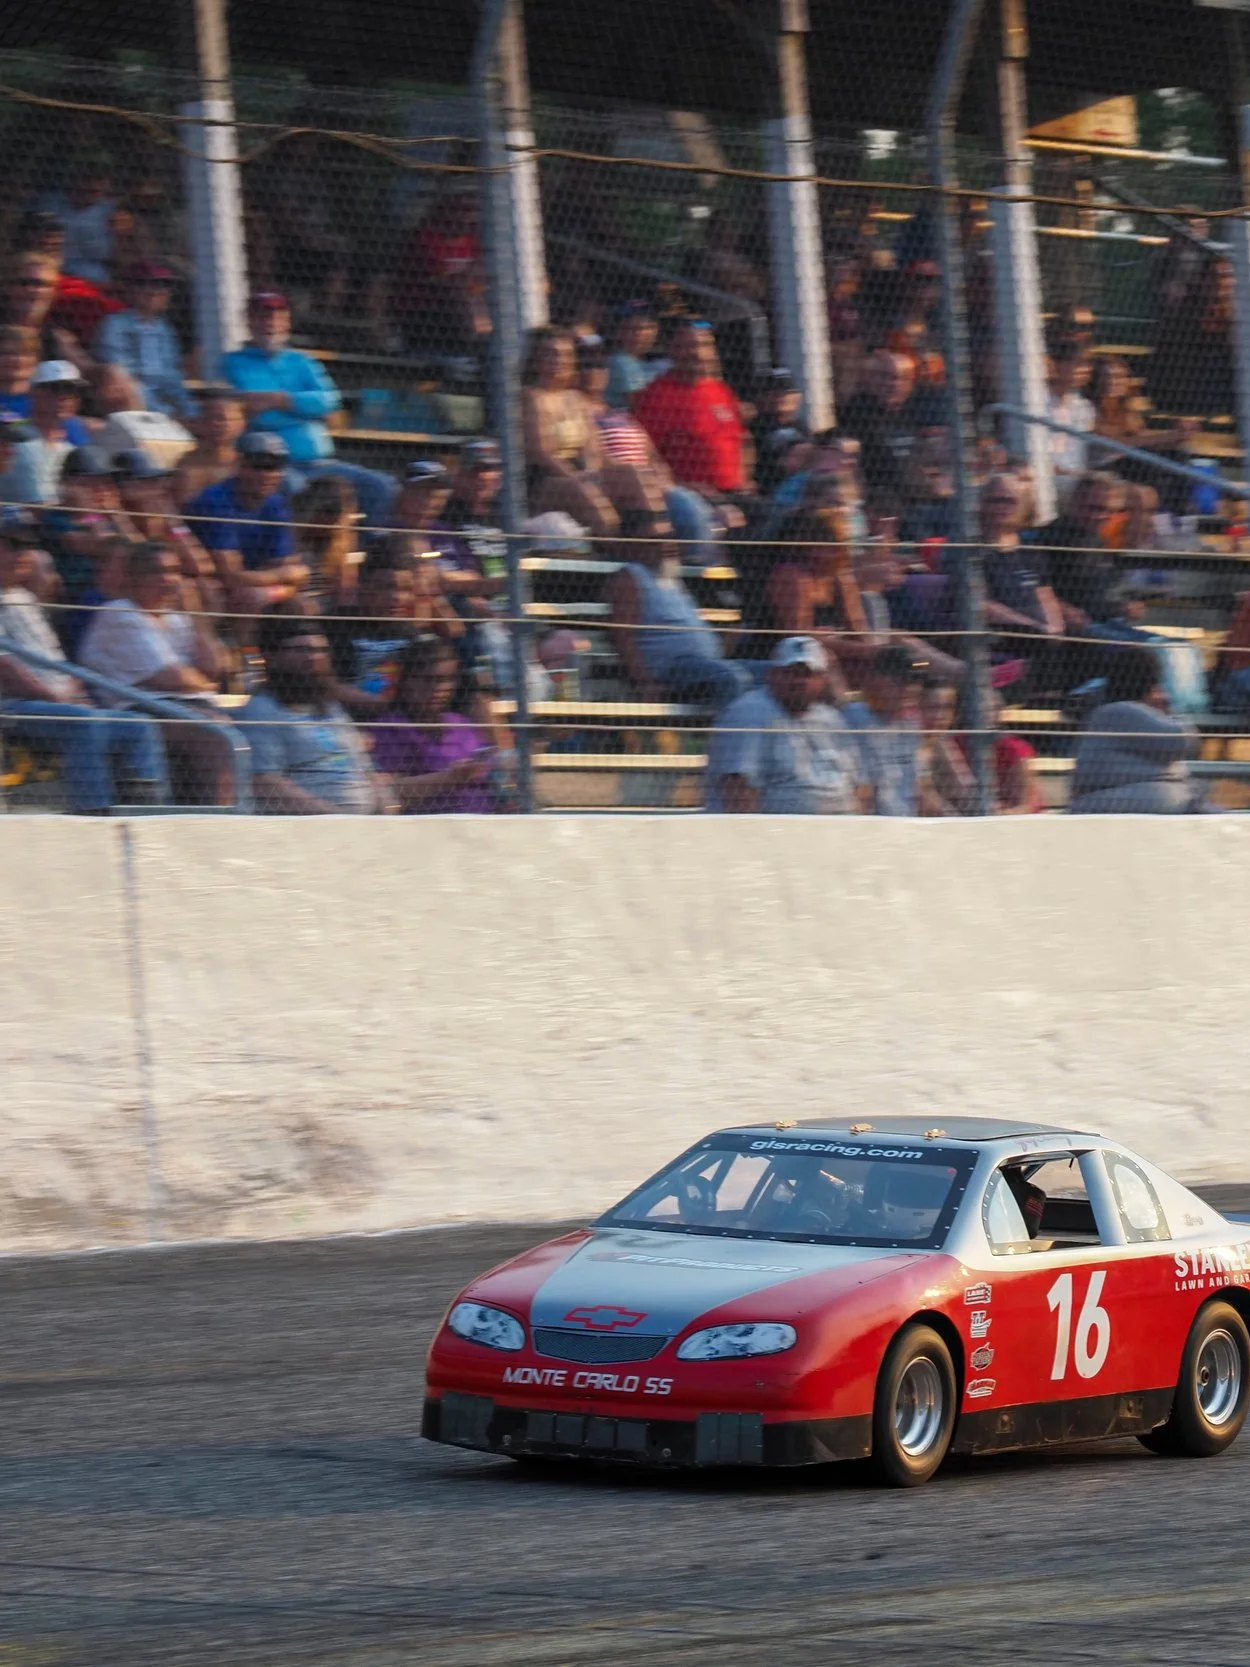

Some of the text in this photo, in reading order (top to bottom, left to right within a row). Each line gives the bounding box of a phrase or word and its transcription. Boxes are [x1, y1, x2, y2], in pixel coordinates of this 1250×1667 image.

[1175, 1279, 1204, 1291] LAWN
[1209, 1275, 1230, 1288] AND
[1046, 1270, 1111, 1381] 16
[502, 1366, 674, 1395] MONTE CARLO SS
